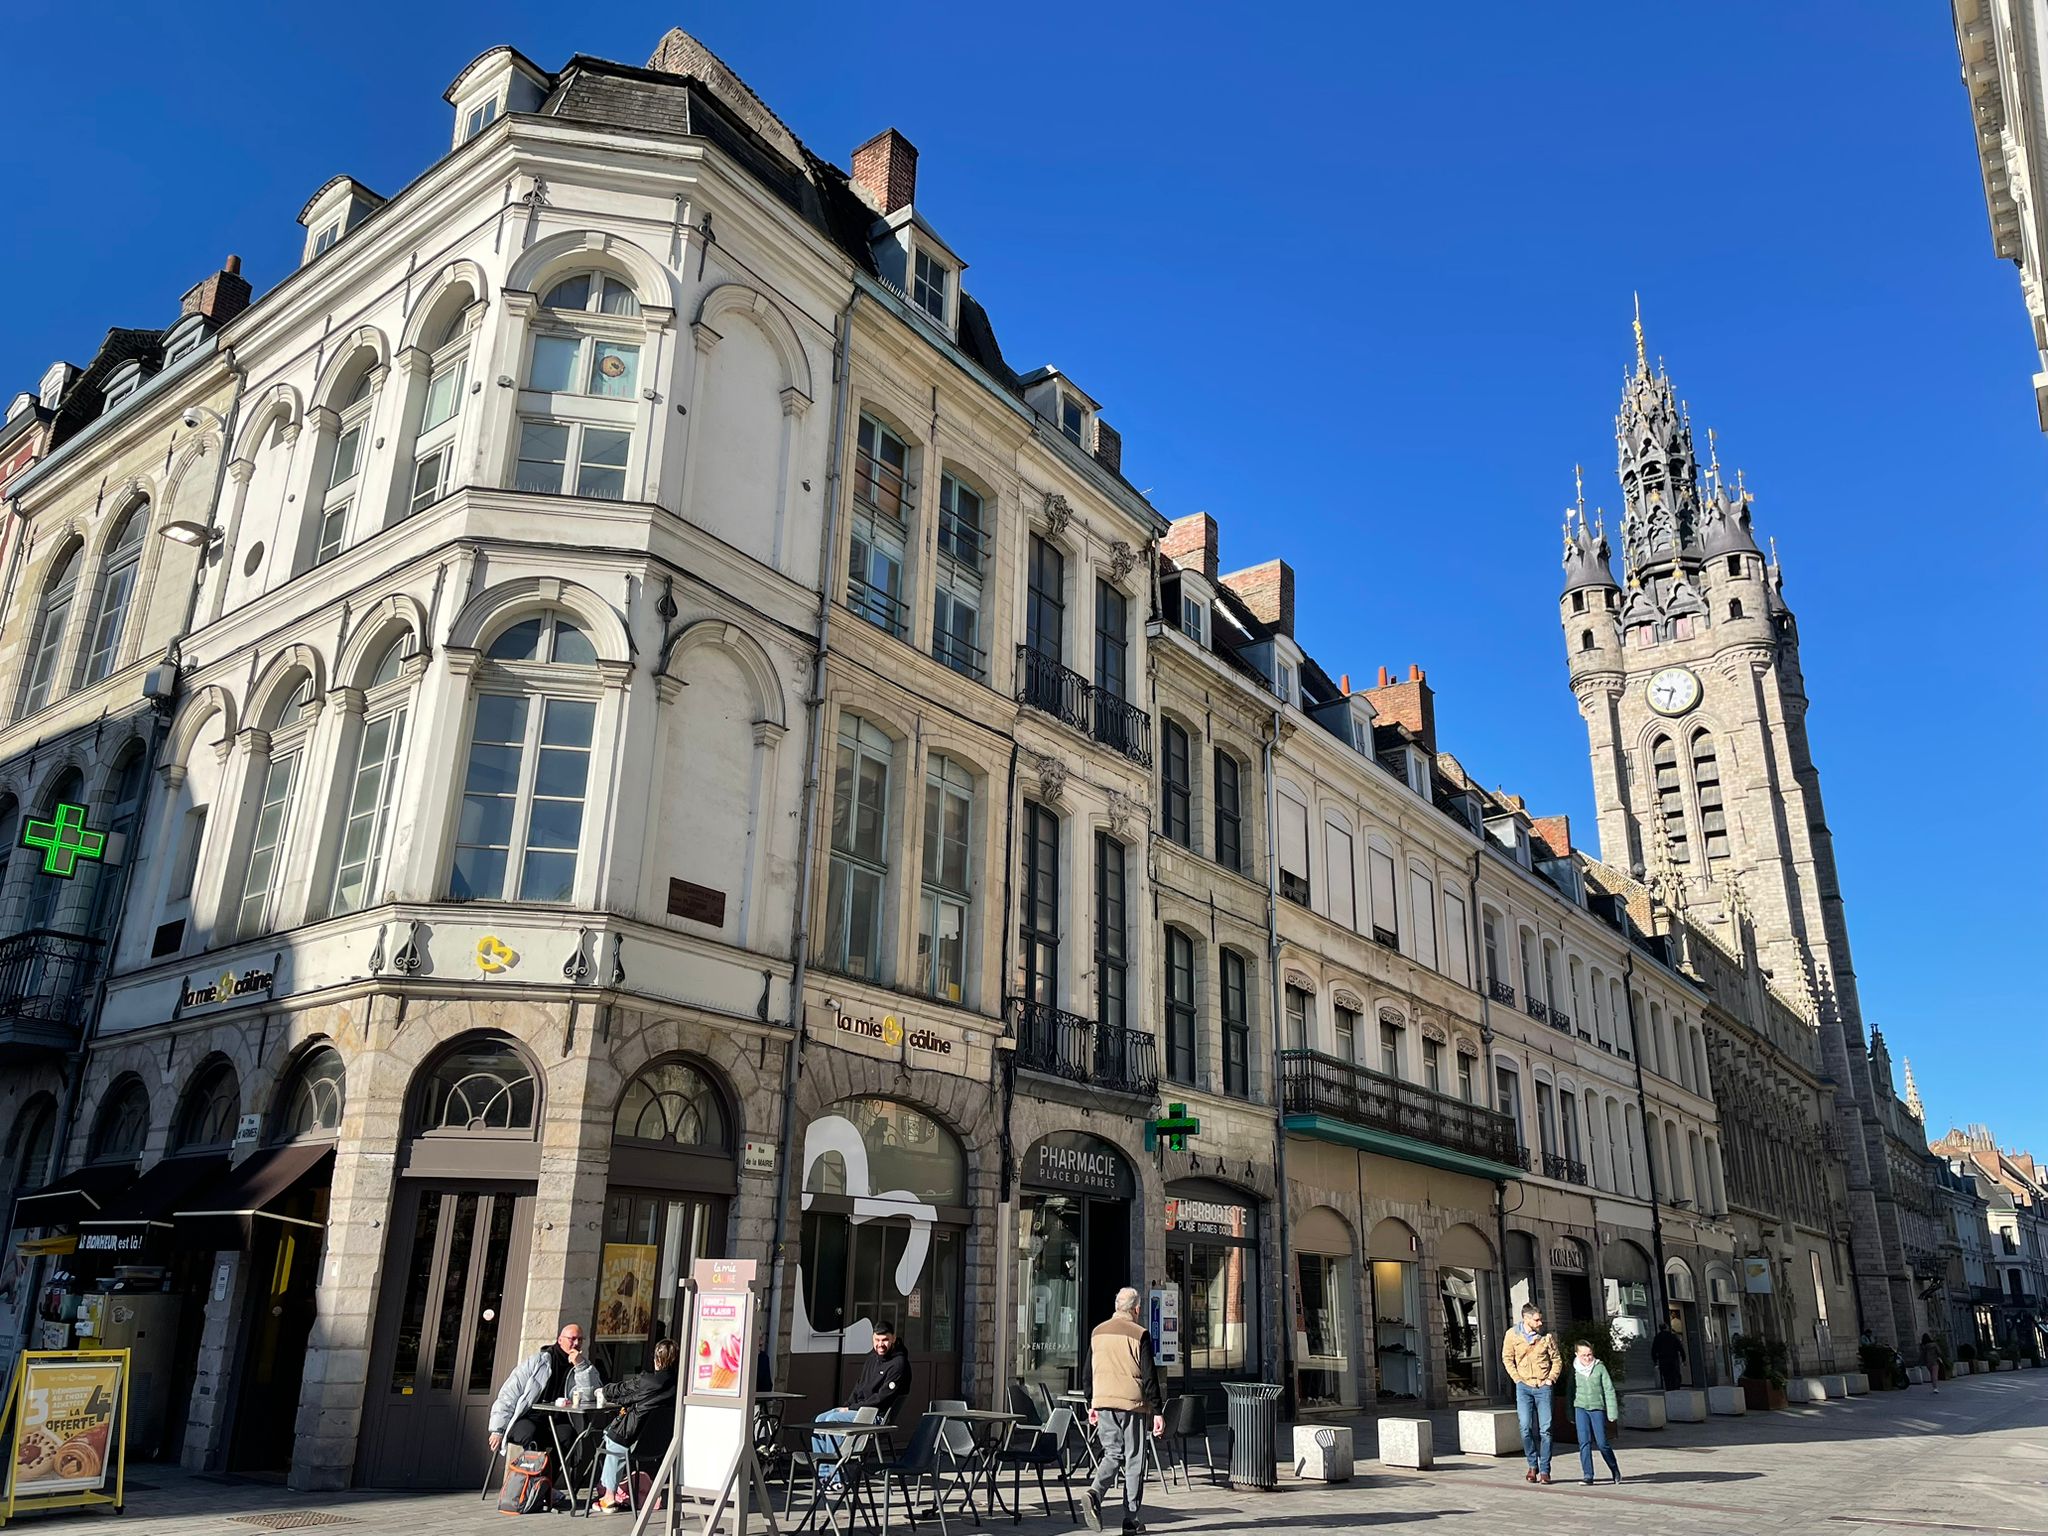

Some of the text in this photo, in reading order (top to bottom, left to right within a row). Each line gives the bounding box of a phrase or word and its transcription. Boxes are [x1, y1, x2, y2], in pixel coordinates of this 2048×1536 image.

[195, 981, 217, 1004] mie
[234, 969, 273, 994] câline
[836, 1007, 952, 1054] la mie câline
[758, 1159, 773, 1167] MAIRIE
[1040, 1145, 1115, 1177] PHARMACIE
[1040, 1168, 1070, 1182] PLACE
[1178, 1220, 1196, 1232] PLACE
[118, 1236, 129, 1249] est
[713, 1262, 737, 1272] la mie
[24, 1385, 111, 1426] 3 4
[69, 1408, 80, 1417] LA
[45, 1416, 96, 1433] OFFERTE
